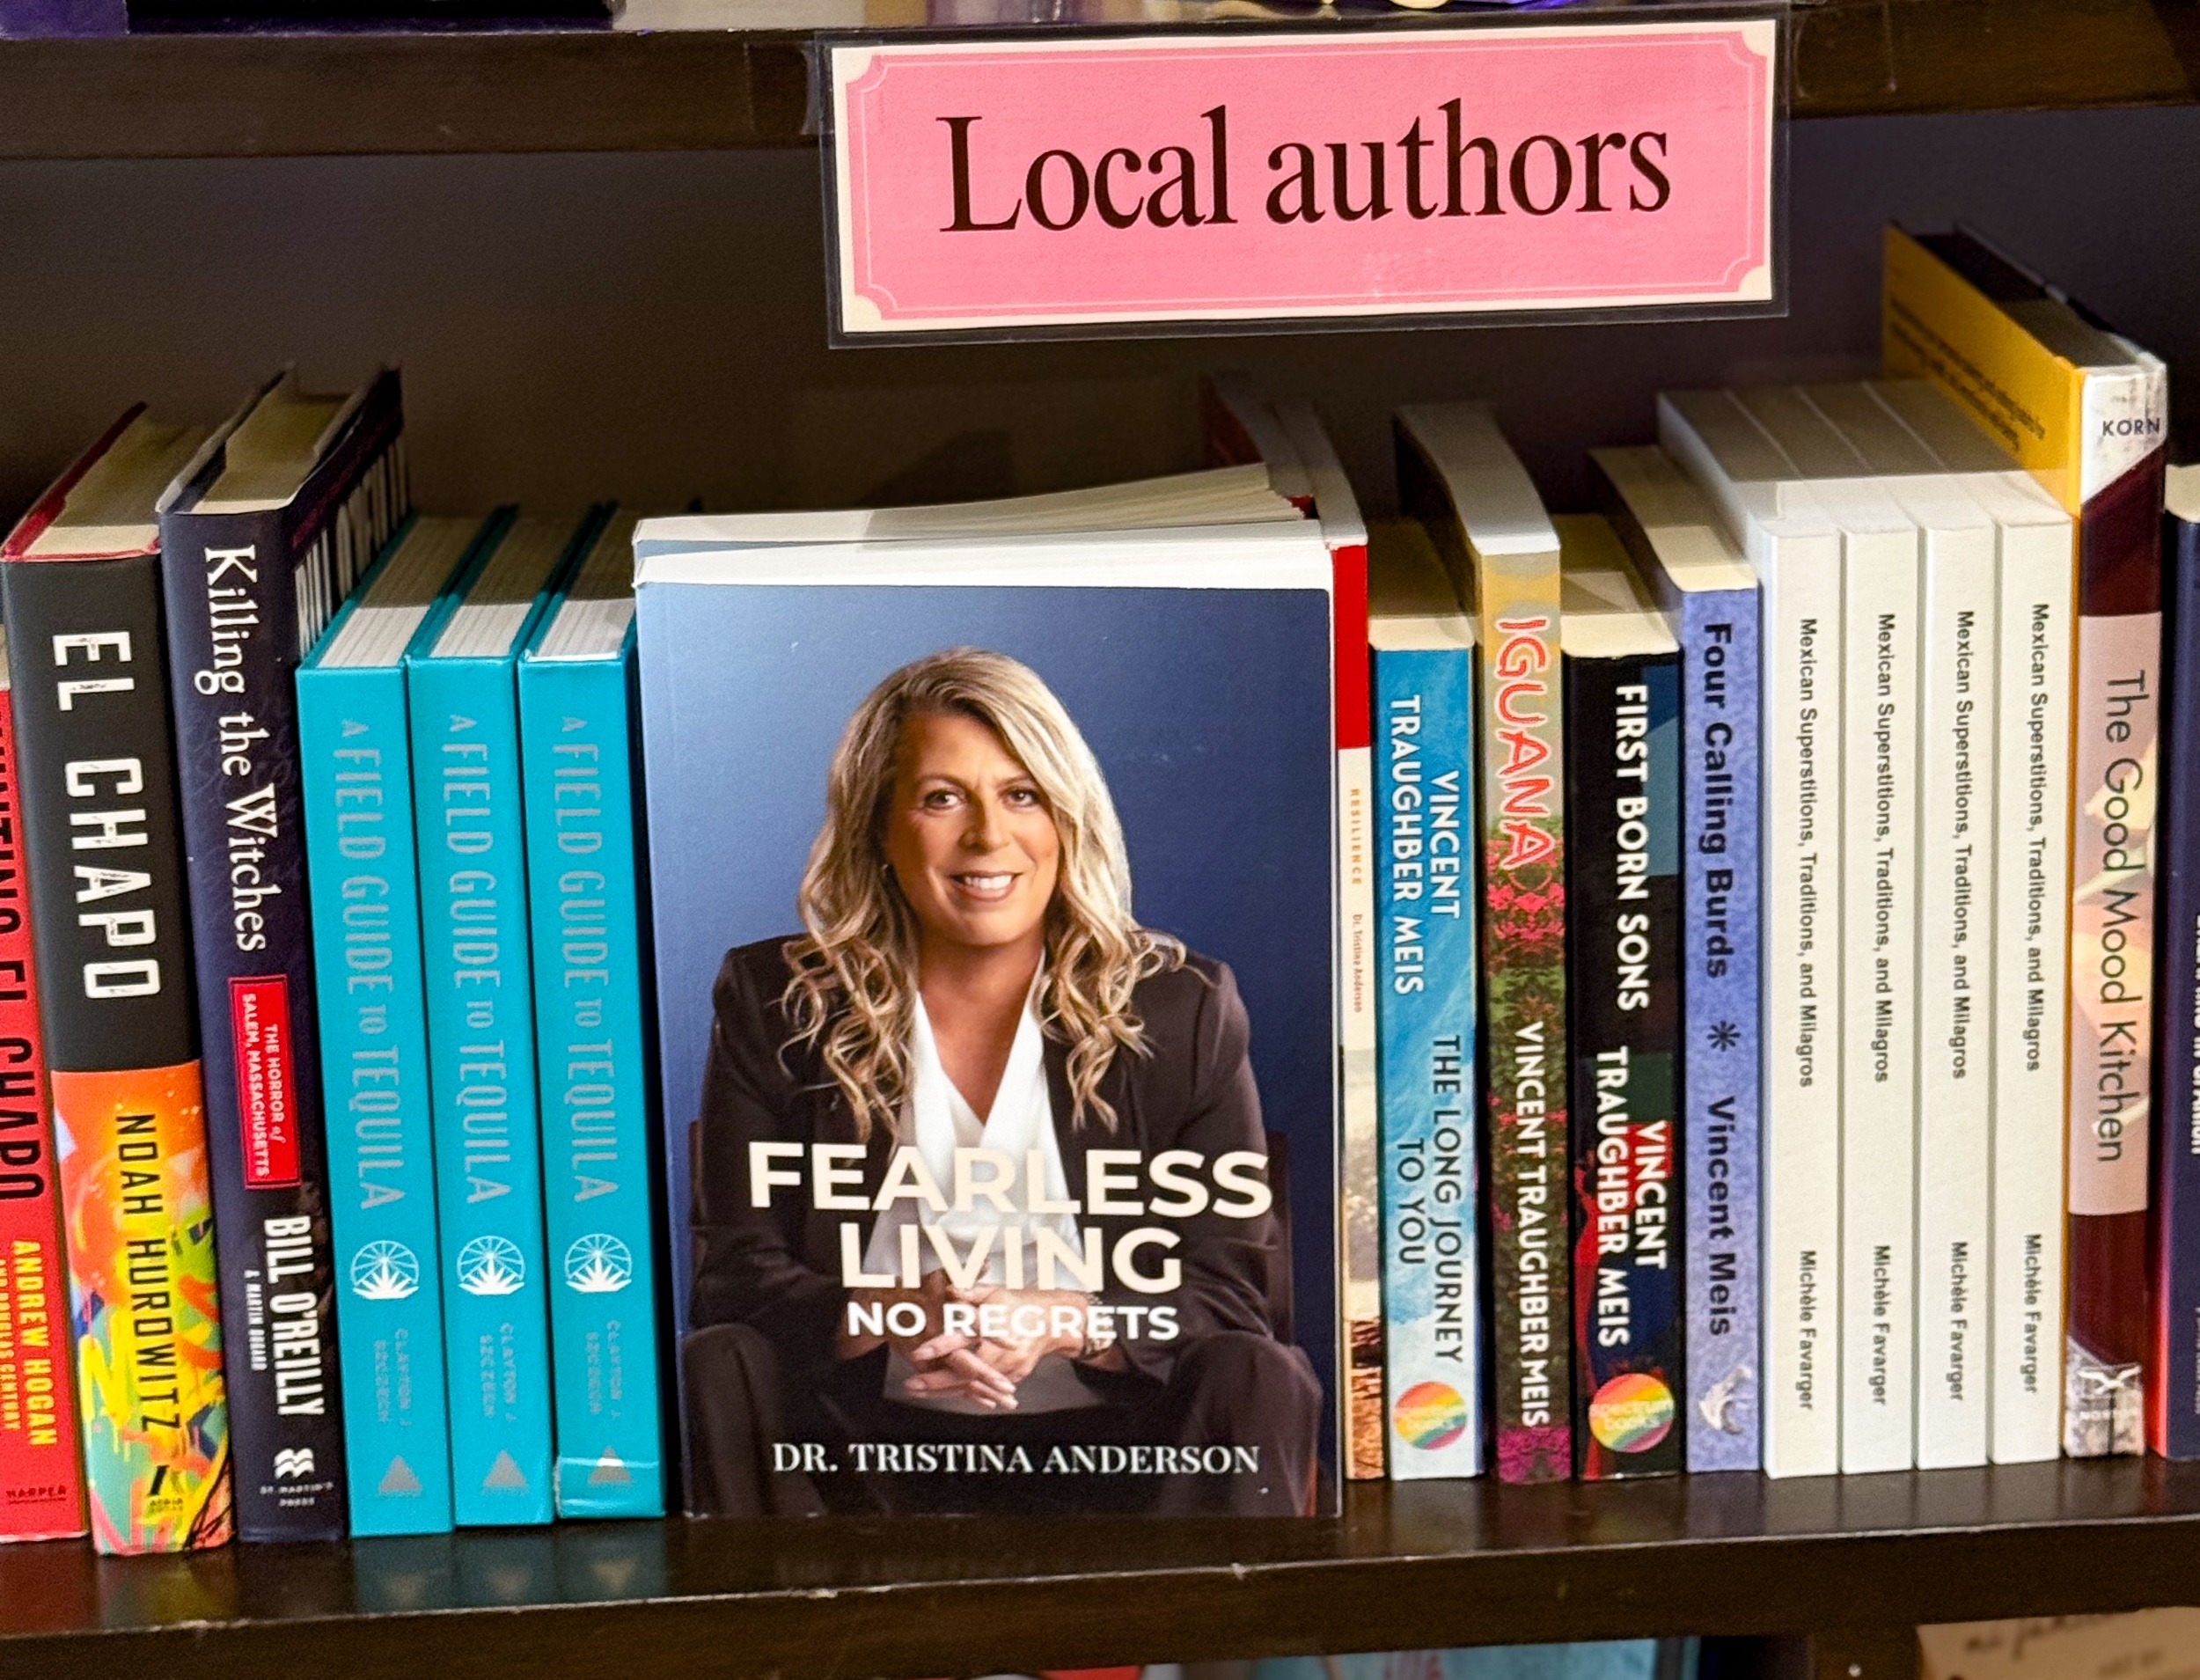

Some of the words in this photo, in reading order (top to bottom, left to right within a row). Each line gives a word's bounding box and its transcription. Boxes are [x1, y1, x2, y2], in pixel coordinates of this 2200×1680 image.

[936, 105, 1238, 232] Local
[1265, 98, 1672, 224] authors
[2101, 416, 2161, 437] KORN
[194, 545, 259, 695] Killing
[1799, 618, 1818, 702] Mexican
[1877, 613, 1896, 698] Mexican
[1955, 611, 1975, 694] Mexican
[2030, 604, 2050, 687] Mexican
[52, 631, 136, 712] EL
[1703, 622, 1733, 709] Four
[2105, 670, 2151, 744] The
[218, 712, 269, 776] the
[341, 719, 370, 739] A
[449, 715, 477, 733] A
[561, 715, 587, 734] A
[1494, 618, 1556, 870] IGUANA
[1616, 684, 1649, 781] FIRST
[2027, 693, 2048, 831] Superstitions,
[334, 747, 387, 860] FIELD
[441, 743, 494, 855] FIELD
[553, 743, 603, 855] FIELD
[1390, 694, 1423, 902] TRAUGHBER
[1698, 722, 1733, 855] Calling
[1796, 708, 1817, 847] Superstitions,
[1874, 703, 1895, 842] Superstitions,
[1952, 700, 1974, 840] Superstitions,
[1350, 789, 1362, 885] RESILIENCE
[1429, 769, 1461, 919] VINCENT
[1616, 796, 1649, 900] BORN
[2101, 758, 2146, 873] Good
[64, 758, 161, 999] CHAPO
[226, 784, 282, 951] Witches
[1796, 852, 1817, 957] Traditions,
[1873, 847, 1895, 953] Traditions,
[1950, 843, 1973, 950] Traditions,
[2026, 836, 2047, 943] Traditions,
[341, 877, 394, 994] GUIDE
[449, 870, 501, 987] GUIDE
[558, 870, 609, 988] GUIDE
[1393, 914, 1425, 995] MEIS
[1617, 913, 1650, 1011] SONS
[1705, 868, 1735, 978] Burds
[2029, 947, 2044, 984] and
[2100, 888, 2143, 1005] Mood
[466, 1000, 495, 1029] TO
[574, 999, 601, 1028] TO
[1800, 962, 1816, 999] and
[1877, 957, 1892, 994] and
[1954, 954, 1969, 991] and
[242, 993, 260, 1048] SALEM,
[264, 1023, 280, 1053] THE
[359, 1004, 388, 1036] TO
[1795, 1005, 1816, 1088] Milagros
[1872, 1000, 1892, 1083] Milagros
[1948, 996, 1970, 1080] Milagros
[2022, 989, 2044, 1072] Milagros
[268, 1057, 285, 1123] HORROR
[1432, 1035, 1461, 1094] THE
[1514, 1021, 1546, 1166] VINCENT
[2097, 1022, 2140, 1163] Kitchen
[248, 1050, 270, 1177] MASSACHUSETTS
[269, 1126, 287, 1144] of
[348, 1045, 405, 1211] TEQUILA
[455, 1039, 512, 1205] TEQUILA
[563, 1038, 619, 1203] TEQUILA
[1433, 1110, 1462, 1204] LONG
[1596, 1046, 1630, 1256] TRAUGHBER
[116, 1113, 165, 1215] NOAH
[747, 1141, 1273, 1219] FEARLESS
[1397, 1137, 1426, 1181] TO
[1633, 1119, 1668, 1270] VINCENT
[1706, 1095, 1736, 1239] Vincent
[265, 1215, 314, 1284] BILL
[840, 1221, 1182, 1294] LIVING
[1398, 1196, 1426, 1266] YOU
[1517, 1169, 1549, 1355] TRAUGHBER
[11, 1240, 50, 1347] ANDREW
[246, 1283, 263, 1325] MARTIN
[847, 1301, 927, 1339] NO
[943, 1303, 1180, 1342] REGRETS
[1427, 1218, 1464, 1364] JOURNEY
[1597, 1266, 1631, 1347] MEIS
[1707, 1252, 1737, 1337] Meis
[126, 1239, 180, 1432] HUROWITZ
[269, 1292, 325, 1415] O'REILLY
[1795, 1327, 1816, 1410] Favarger
[1869, 1322, 1890, 1405] Favarger
[1946, 1318, 1968, 1401] Favarger
[2020, 1311, 2042, 1394] Favarger
[23, 1359, 58, 1447] HOGAN
[1521, 1358, 1551, 1427] MEIS
[6, 1486, 67, 1497] HARPER
[773, 1442, 839, 1473] DR.
[849, 1443, 1033, 1475] TRISTINA
[1041, 1445, 1260, 1475] ANDERSON
